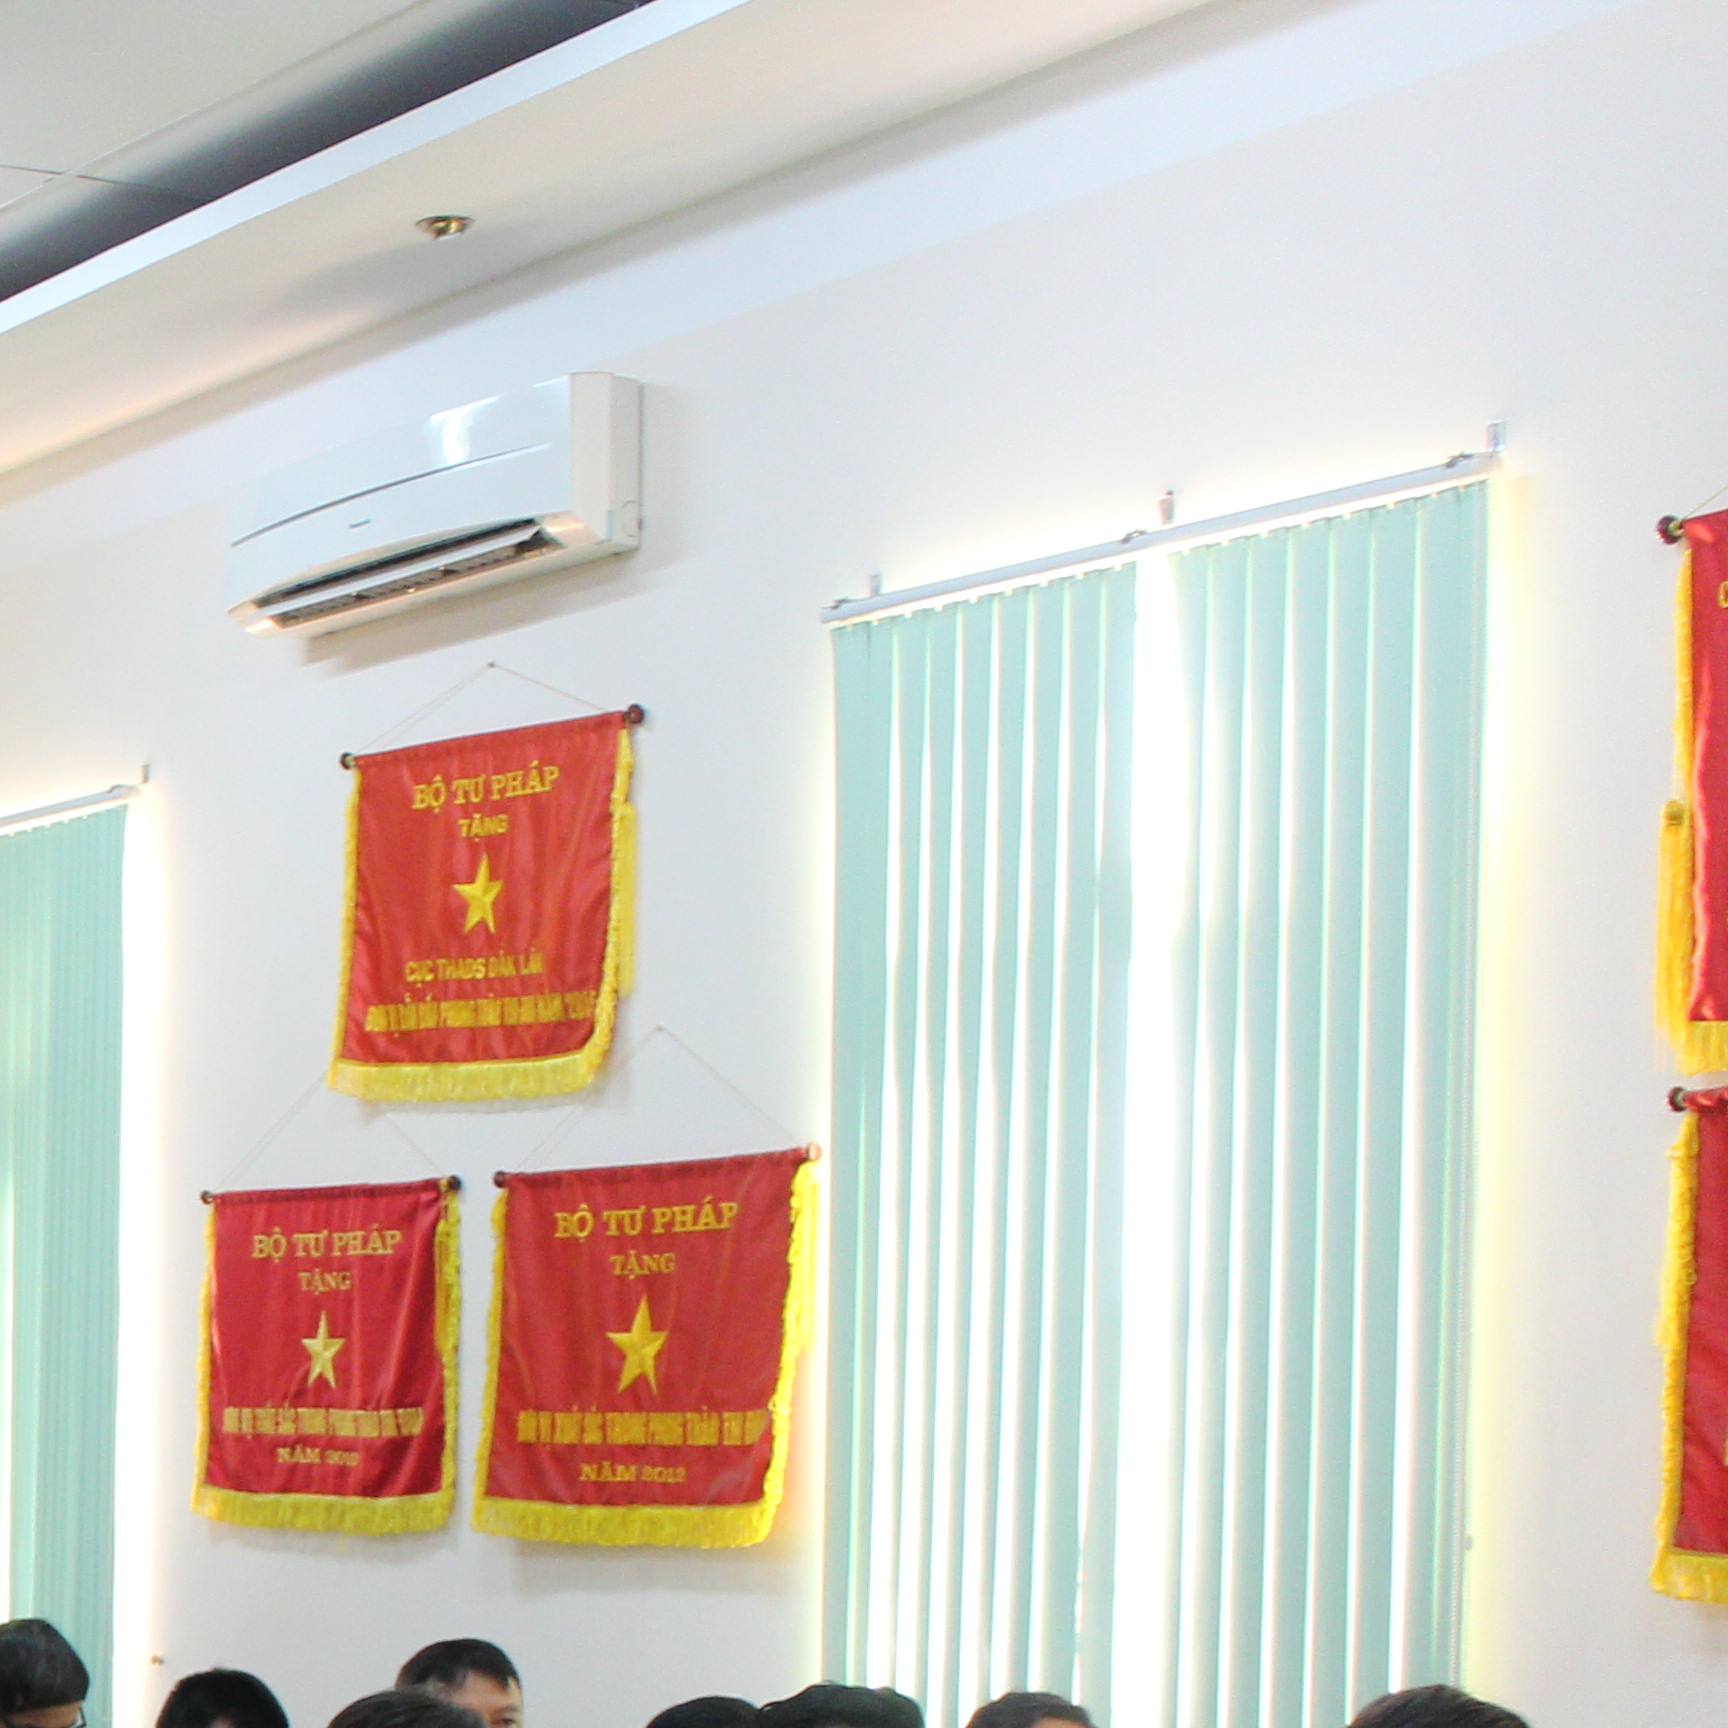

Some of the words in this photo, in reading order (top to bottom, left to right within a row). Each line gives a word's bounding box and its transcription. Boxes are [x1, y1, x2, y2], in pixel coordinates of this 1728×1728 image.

[412, 774, 447, 813] BỘ
[451, 774, 487, 805] TƯ
[490, 760, 561, 800] PHÁP
[457, 813, 509, 842] TẶNG
[554, 1203, 594, 1243] BỘ
[602, 1205, 647, 1236] TƯ
[651, 1195, 739, 1235] PHÁP
[251, 1226, 288, 1264] BỘ
[293, 1229, 329, 1258] TƯ
[331, 1223, 403, 1257] PHÁP
[298, 1268, 352, 1296] TẶNG
[609, 1249, 677, 1280] TẶNG
